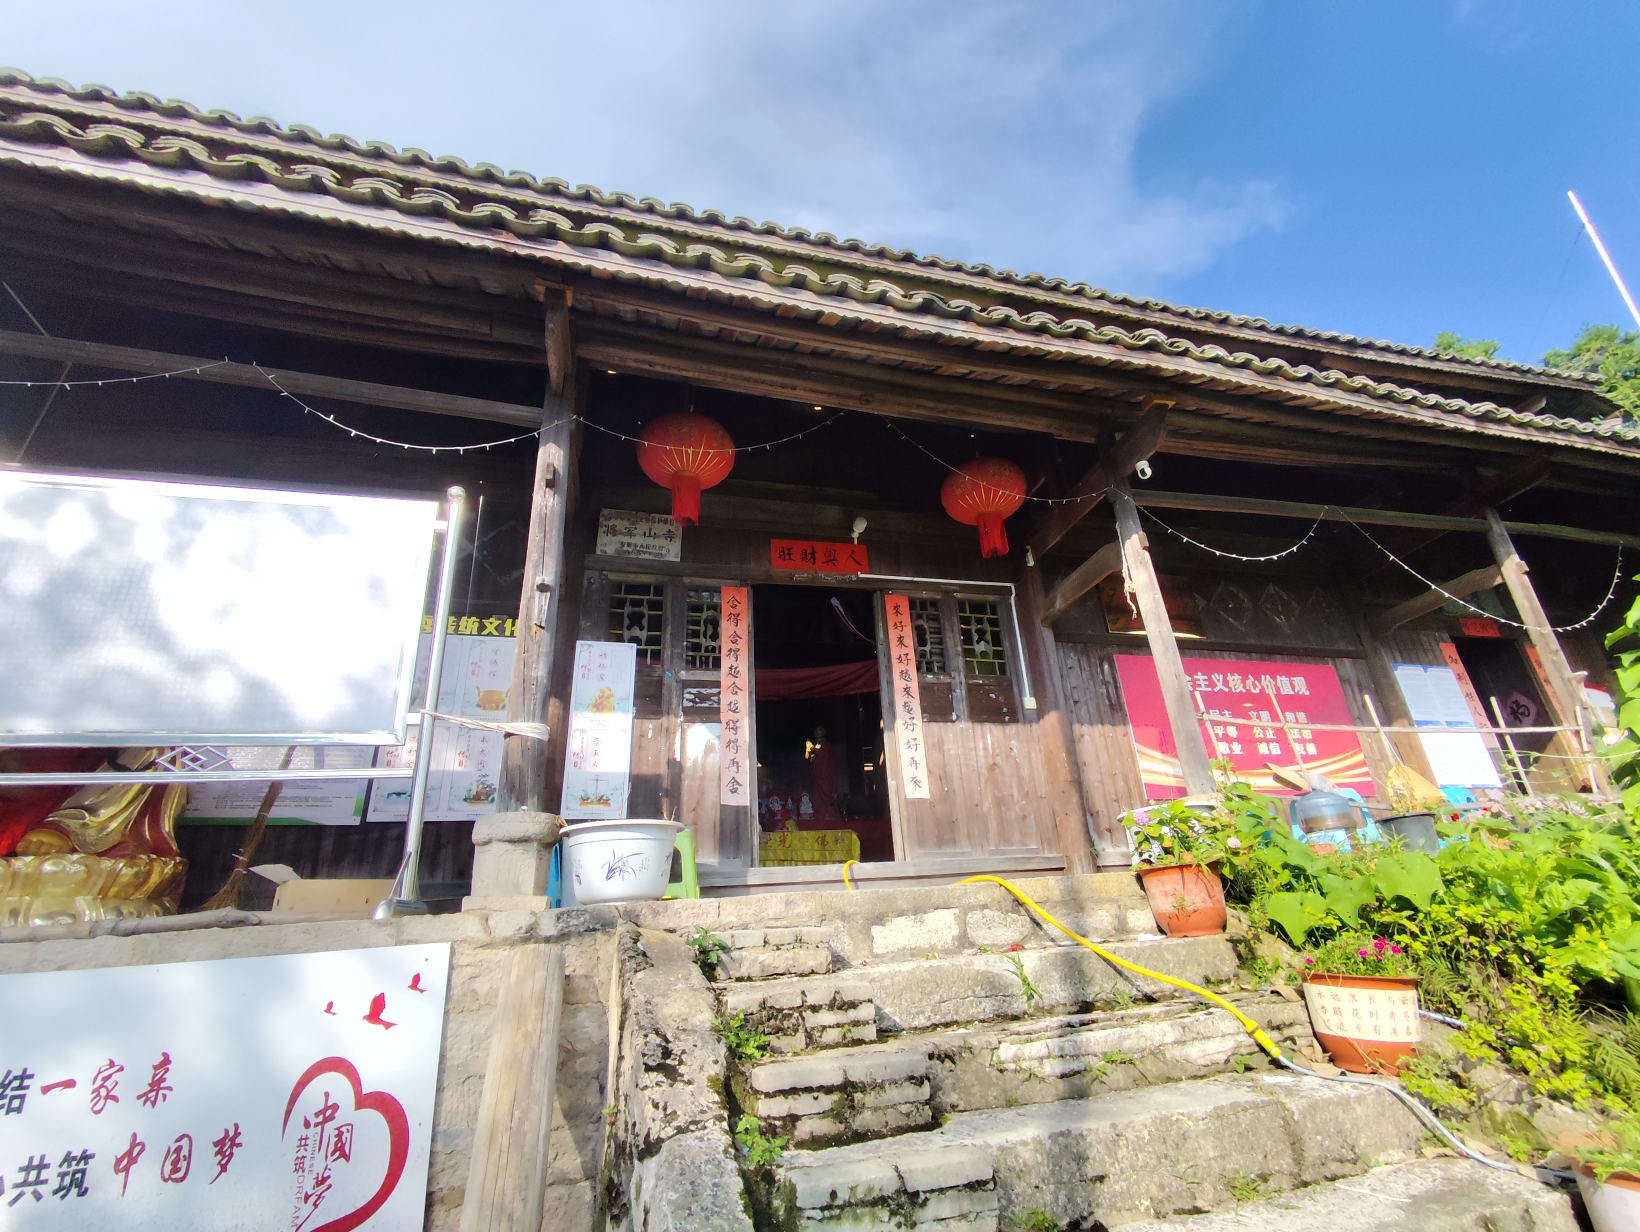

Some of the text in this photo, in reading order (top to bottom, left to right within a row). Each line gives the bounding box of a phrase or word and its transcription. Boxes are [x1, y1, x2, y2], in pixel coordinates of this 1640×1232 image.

[0, 1122, 244, 1210] 共筑中国梦
[292, 1133, 310, 1174] 共筑
[307, 1131, 319, 1175] CHINESE
